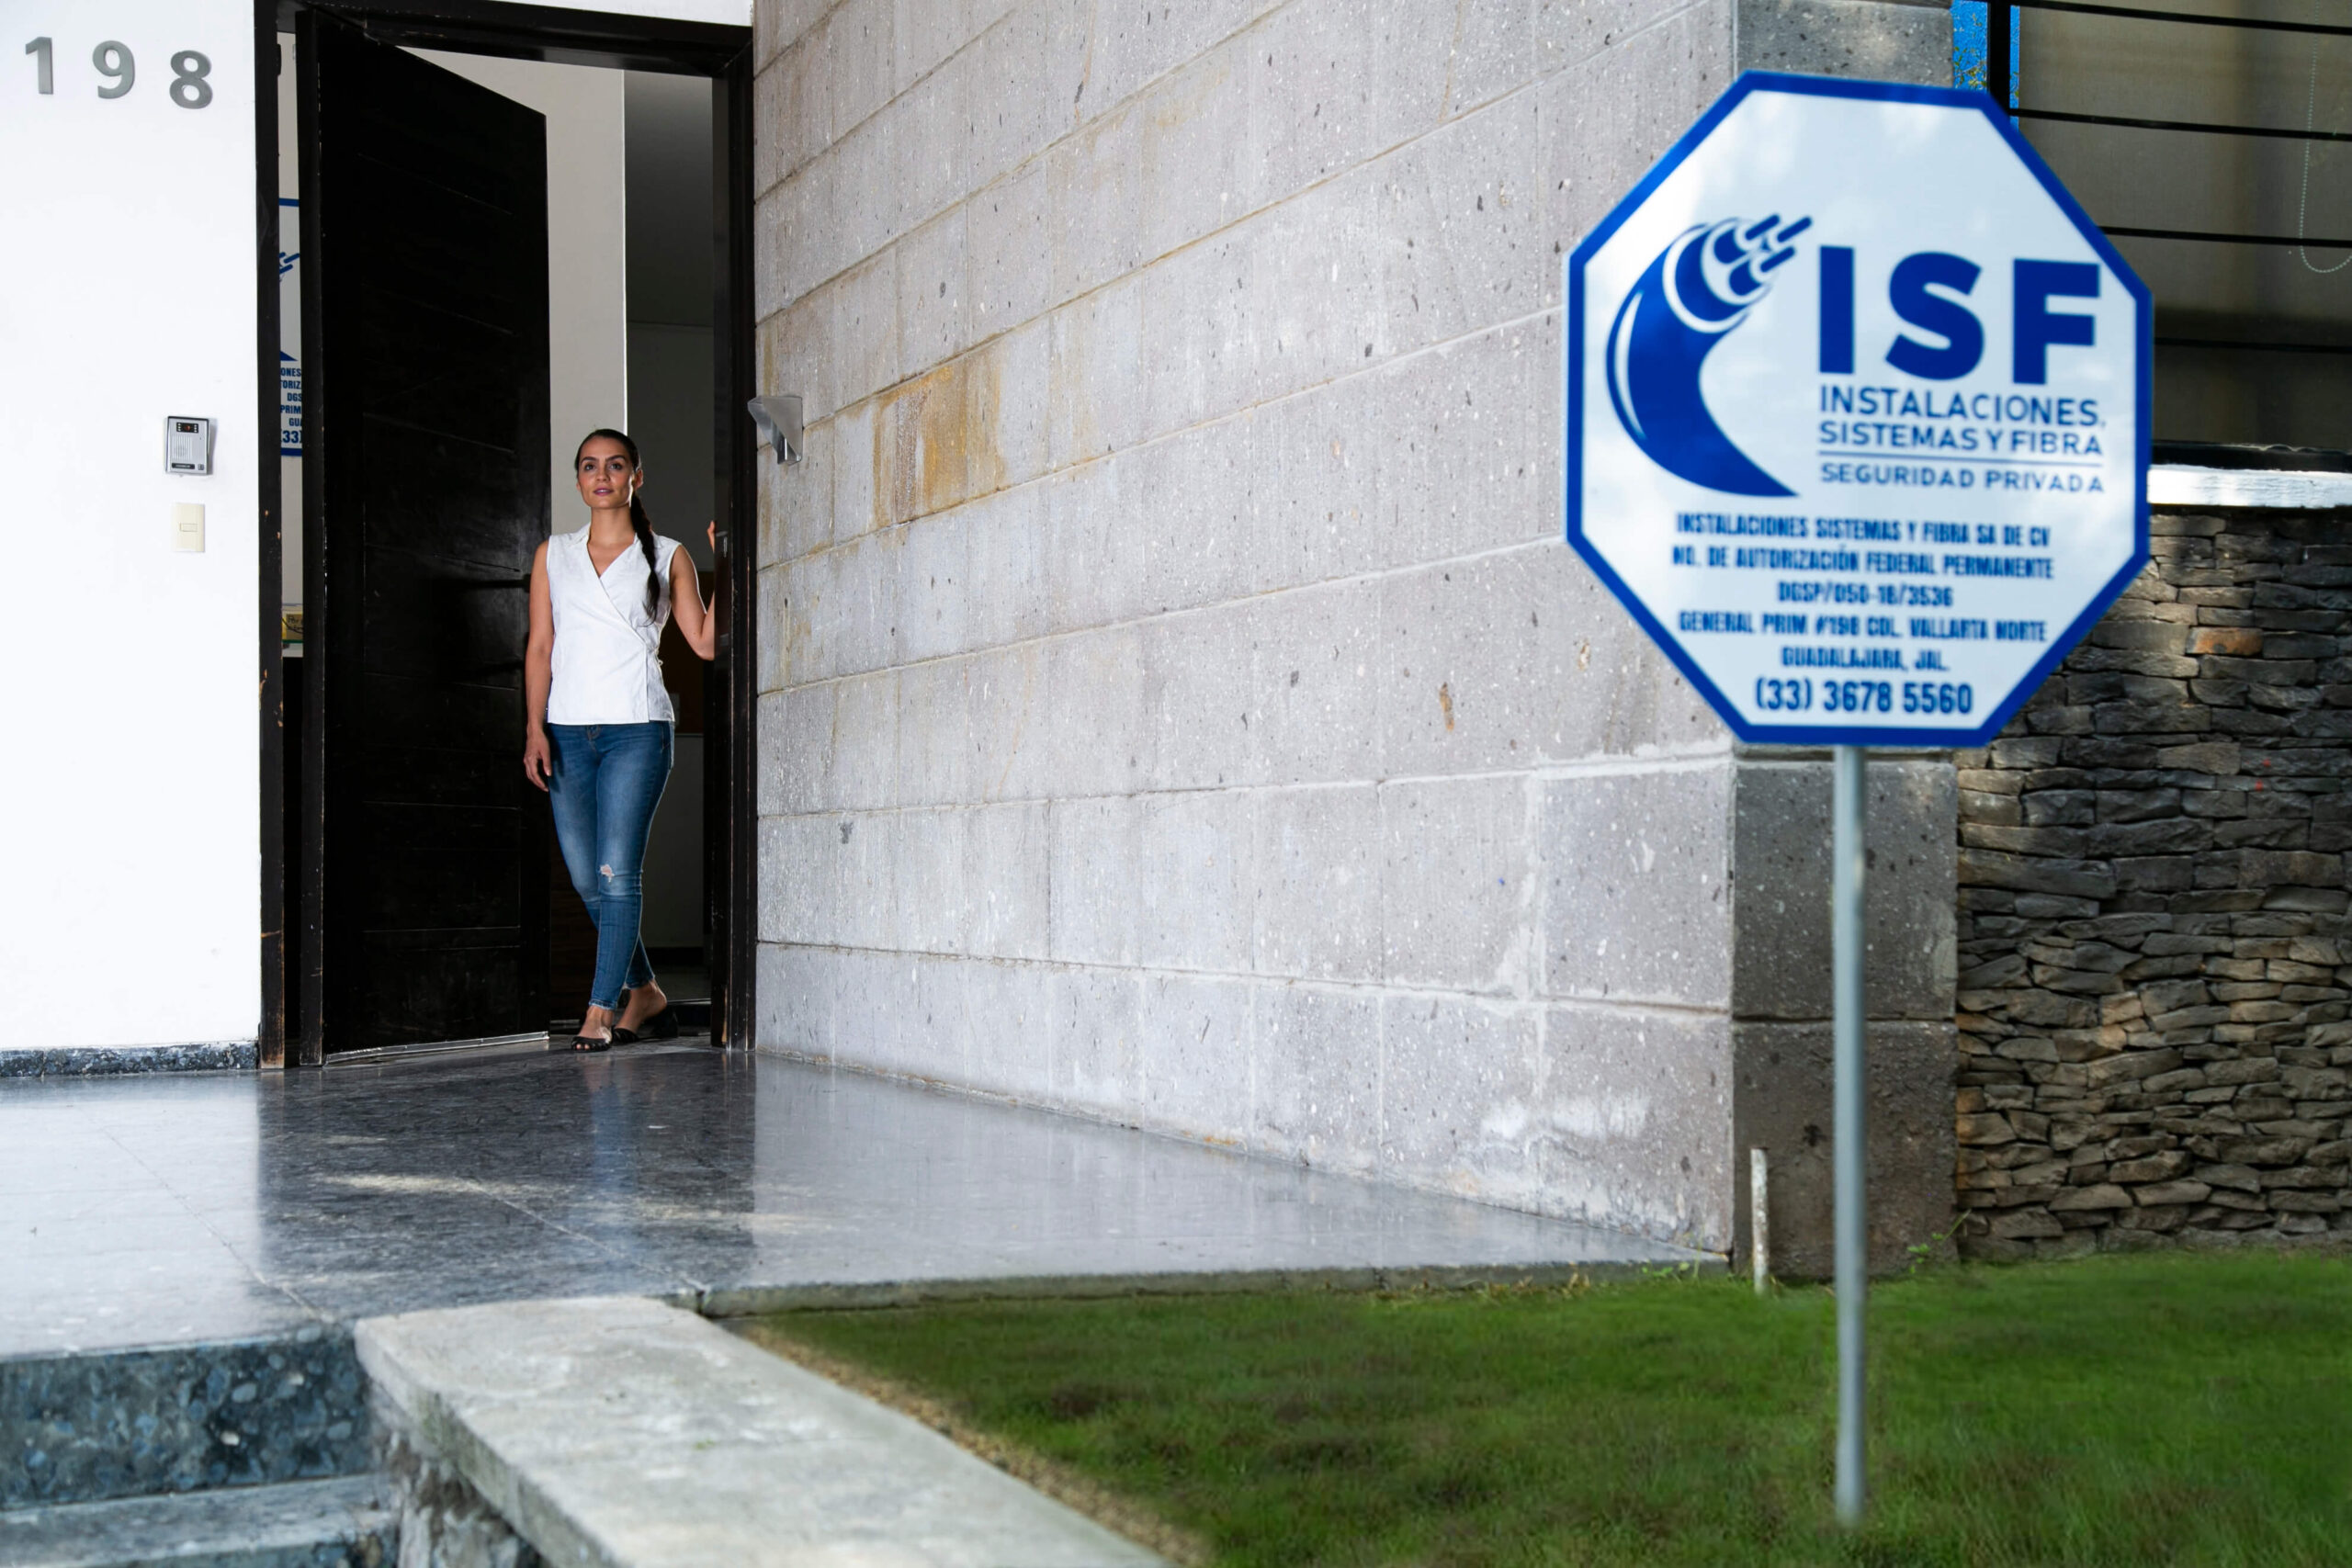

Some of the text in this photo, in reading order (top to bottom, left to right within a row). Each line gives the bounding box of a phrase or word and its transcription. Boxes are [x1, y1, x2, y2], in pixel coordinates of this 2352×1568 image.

[25, 36, 214, 109] 198
[1818, 245, 2101, 385] ISF
[1819, 420, 2103, 456] SISTEMAS Y FIBRA
[1820, 462, 2104, 493] SEGURIDAD PRIVADA
[1677, 513, 2051, 547] INSTALACIONES SISTEMAS Y FIBRA SA DE CV
[1708, 547, 1728, 567] DE
[1866, 551, 1936, 574] FEDERAL
[1944, 555, 2054, 579] PERMANENTE
[1679, 611, 1754, 634] GENERAL
[1761, 614, 1806, 635] PRIM
[1909, 618, 1988, 639] VALLARTA
[1996, 620, 2047, 642] NORTE
[1755, 677, 1973, 715] (33) 3678 5560
